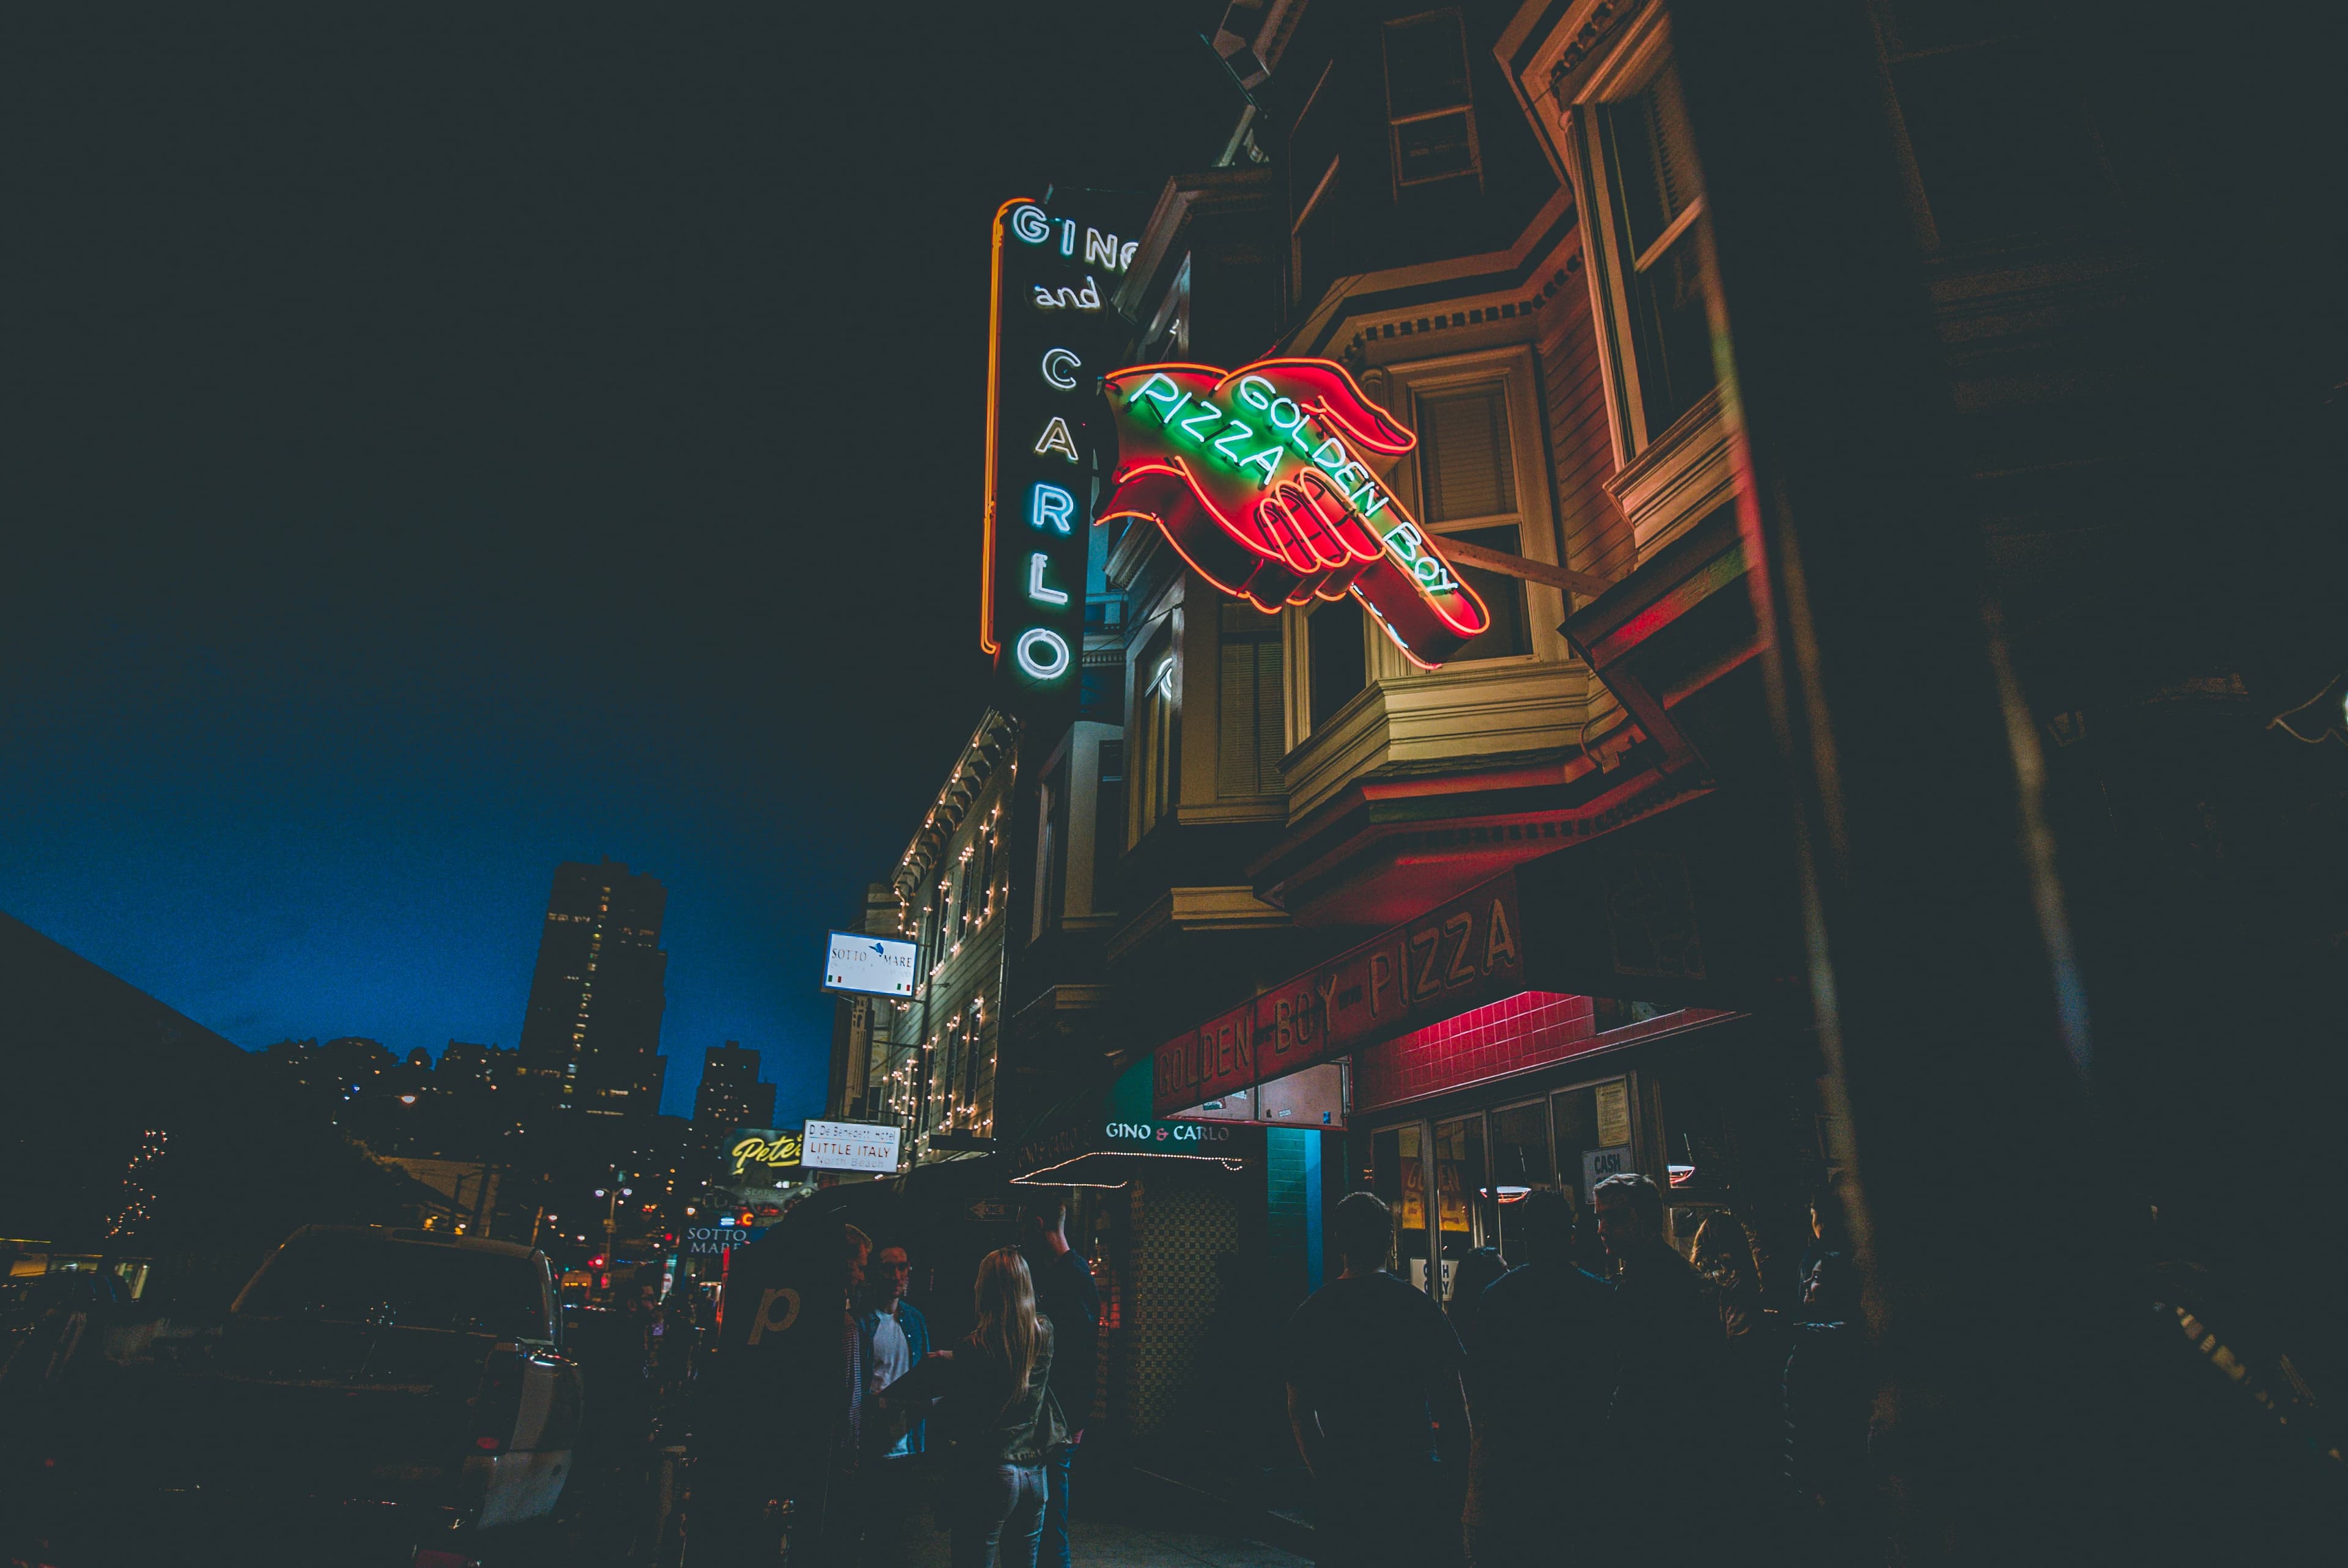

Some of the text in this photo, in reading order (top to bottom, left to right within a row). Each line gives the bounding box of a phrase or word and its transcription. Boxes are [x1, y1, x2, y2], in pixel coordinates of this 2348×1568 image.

[1033, 275, 1101, 307] and
[1129, 372, 1284, 486] PIZZA
[1239, 375, 1389, 517] GOLDEN
[1017, 348, 1082, 679] CARLO
[1383, 521, 1458, 592] BOY
[832, 948, 867, 962] SOTTO
[884, 954, 912, 968] MARE
[1157, 899, 1515, 1099] GOLDEN BOY PIZZA
[1106, 1122, 1230, 1141] GINO & CARLO
[811, 1142, 891, 1158] LITTLE ITALY
[1594, 1153, 1621, 1174] CASH
[687, 1228, 747, 1242] SOTTO
